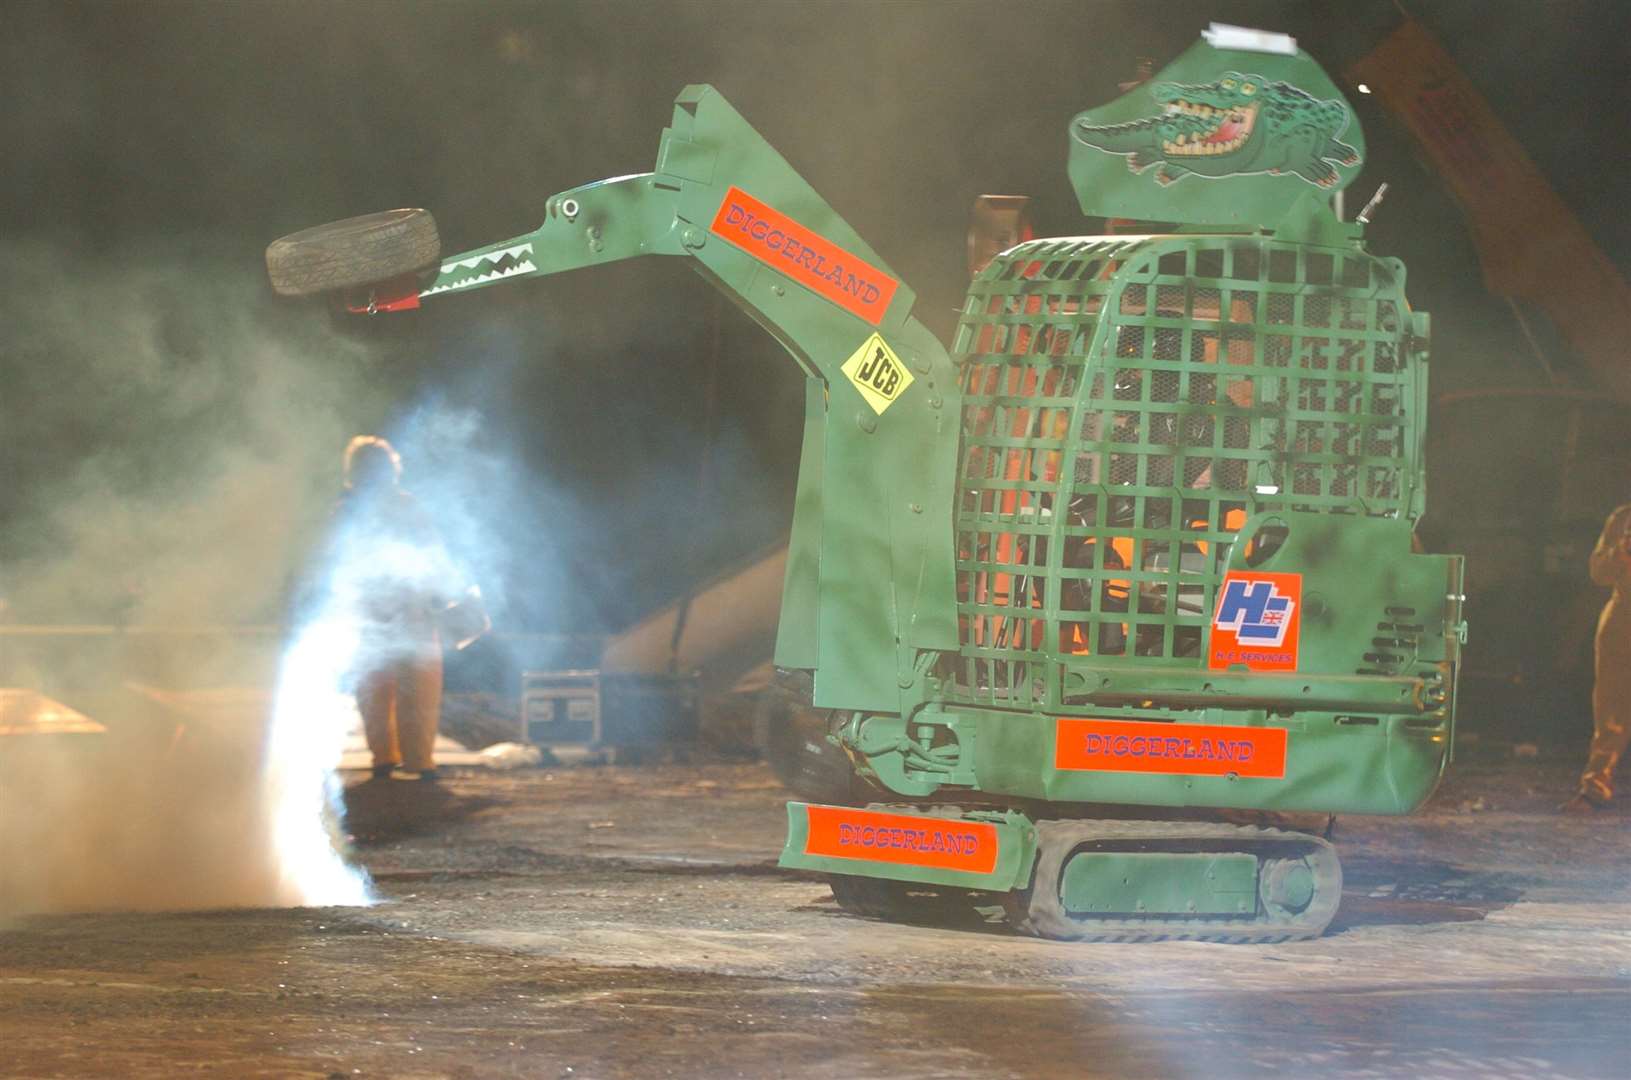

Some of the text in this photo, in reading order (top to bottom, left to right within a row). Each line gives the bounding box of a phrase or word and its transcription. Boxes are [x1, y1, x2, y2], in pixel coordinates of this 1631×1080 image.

[726, 204, 881, 305] DIGGERLAND
[858, 346, 900, 396] JCB
[1086, 734, 1253, 761] DIGGERLAND
[839, 823, 978, 854] DIGGERLAND
